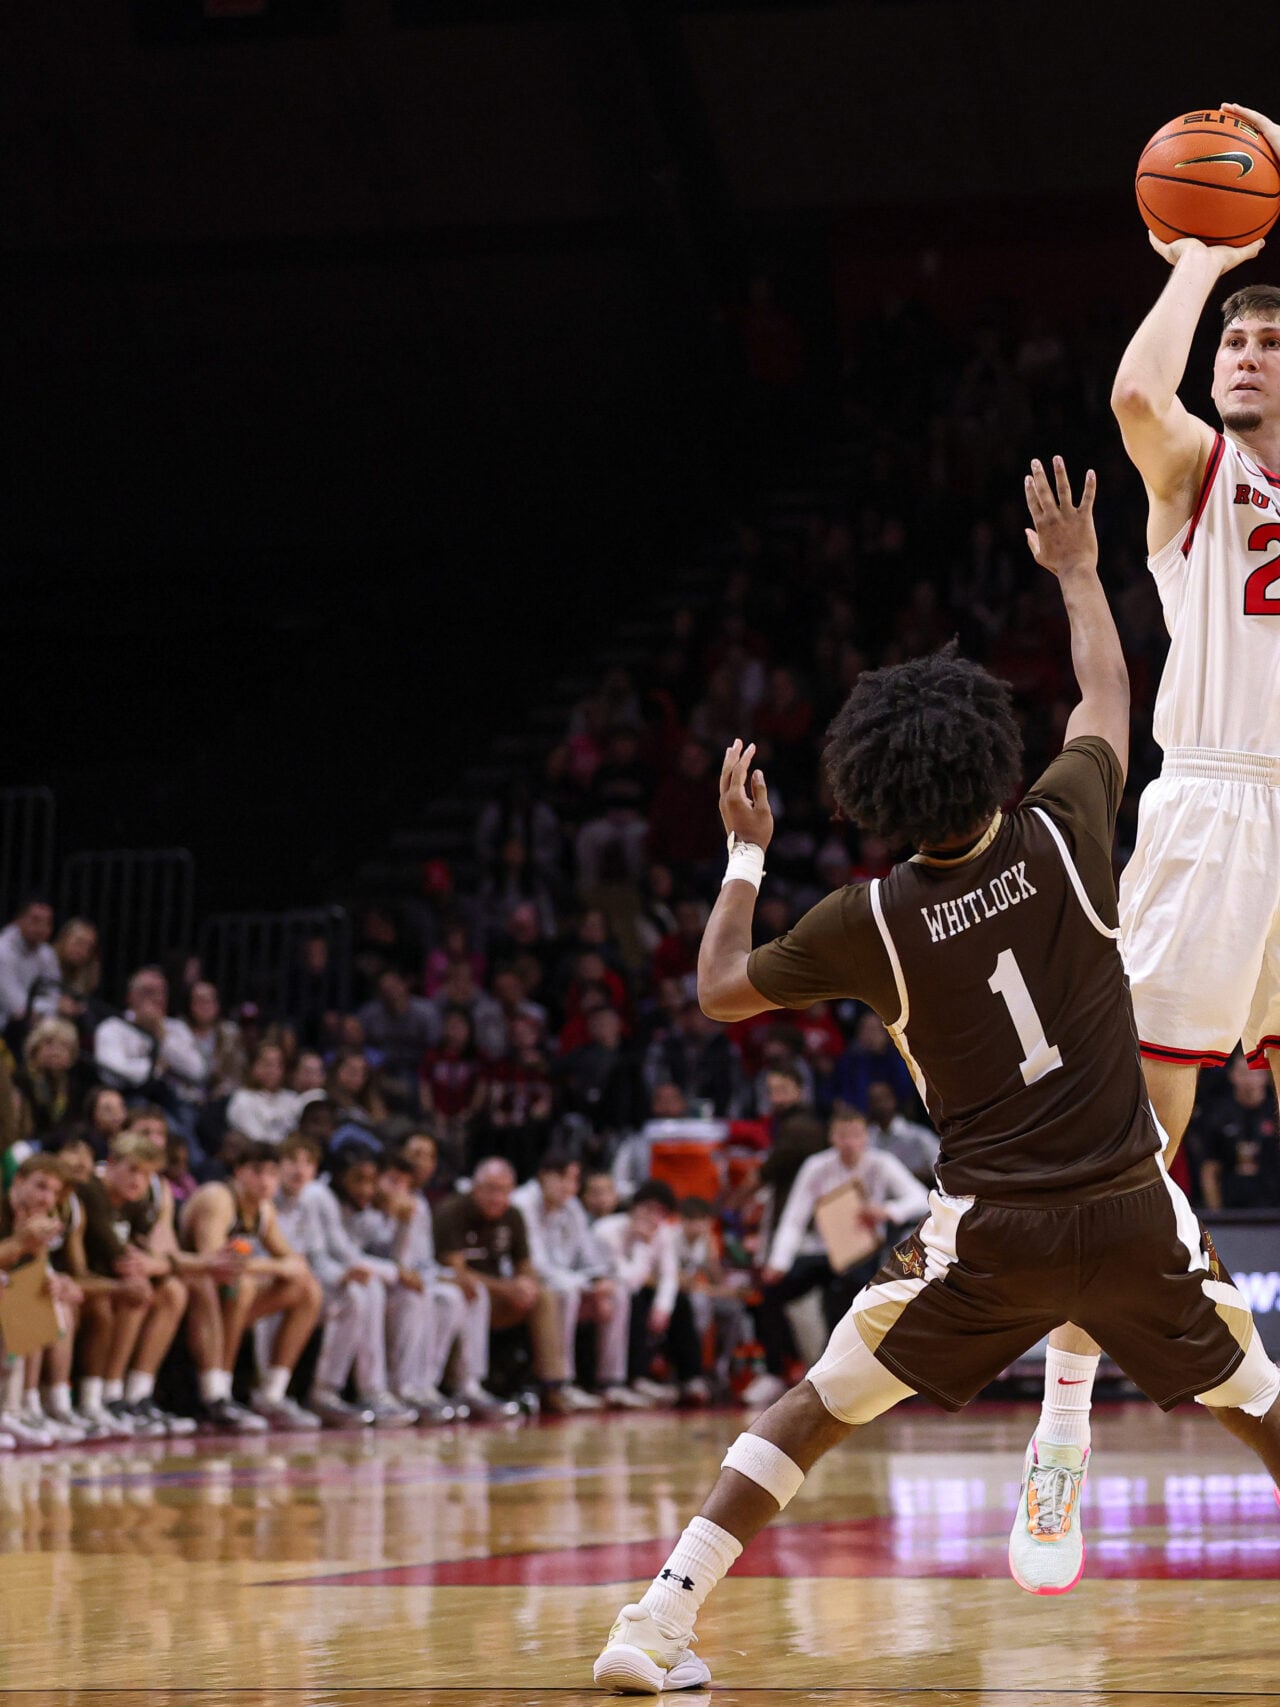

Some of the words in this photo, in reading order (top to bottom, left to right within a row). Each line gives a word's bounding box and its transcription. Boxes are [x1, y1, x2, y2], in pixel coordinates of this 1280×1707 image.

[1183, 112, 1259, 140] ELITE
[921, 860, 1037, 943] WHITLOCK
[987, 948, 1063, 1086] 1
